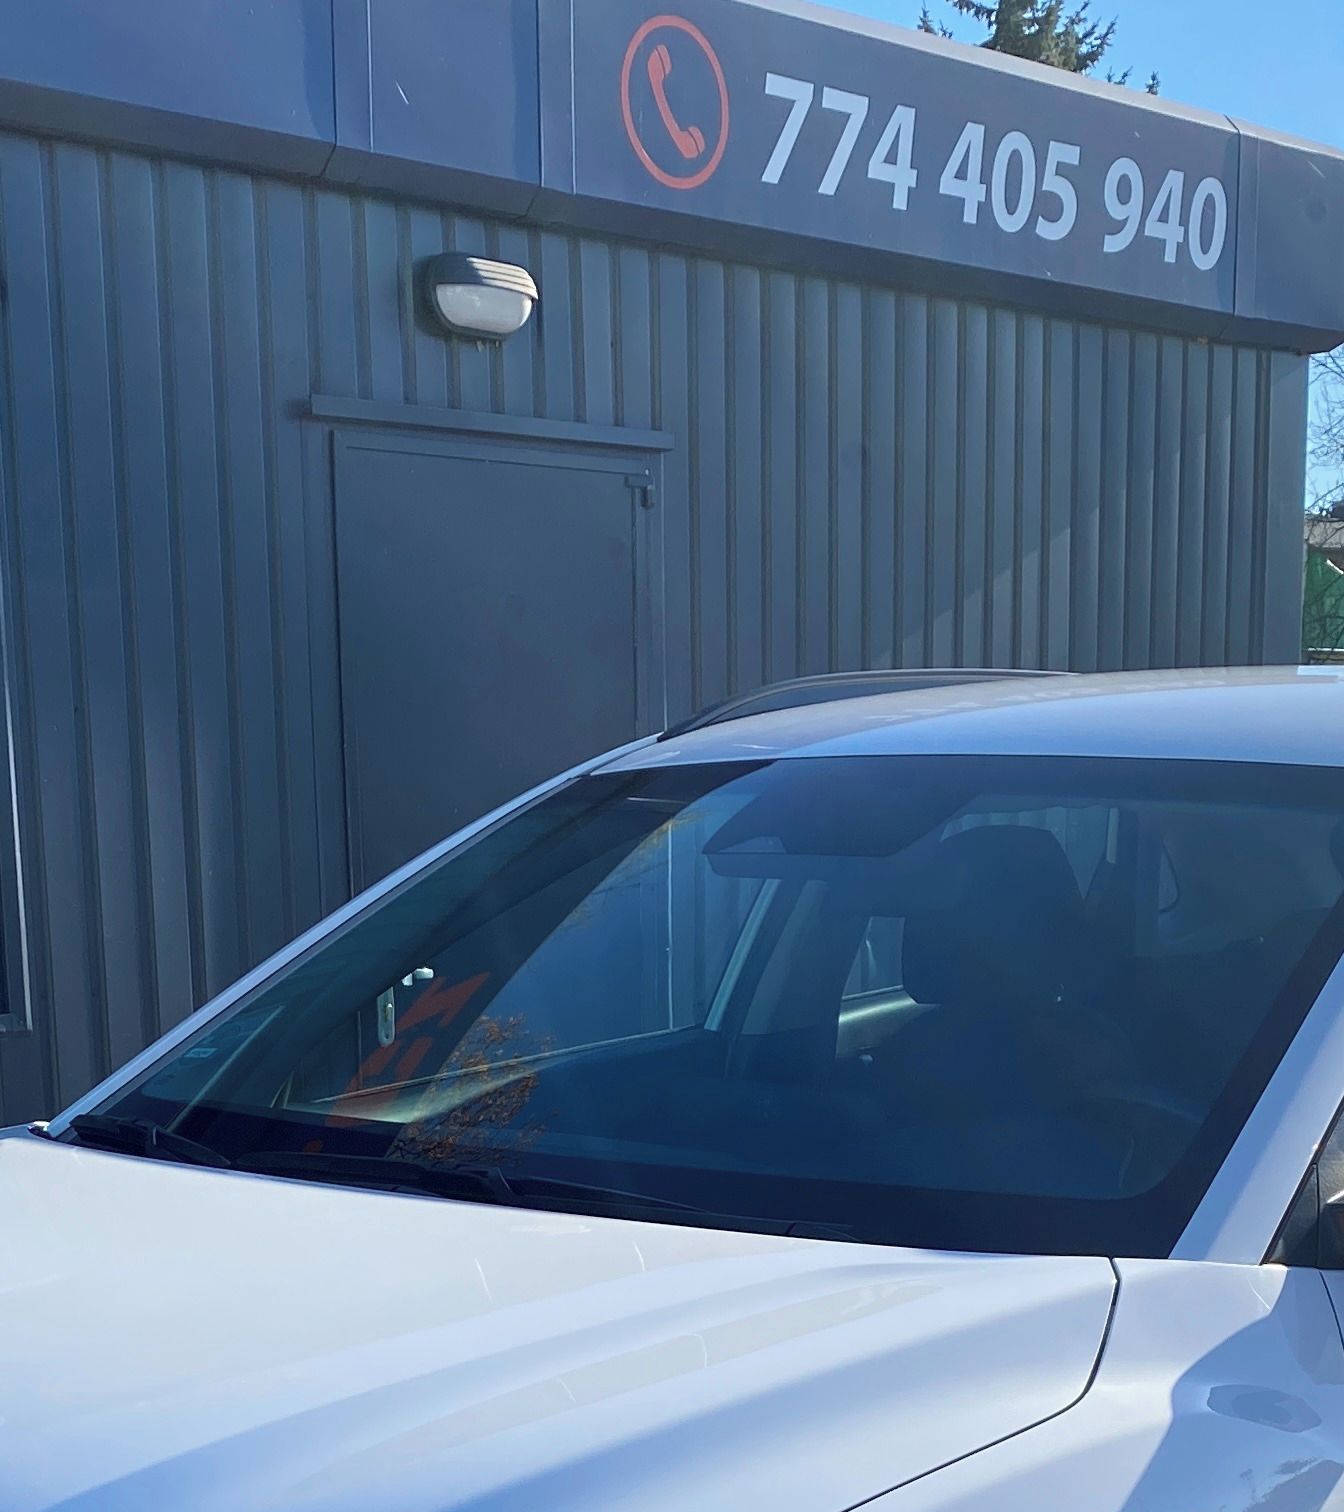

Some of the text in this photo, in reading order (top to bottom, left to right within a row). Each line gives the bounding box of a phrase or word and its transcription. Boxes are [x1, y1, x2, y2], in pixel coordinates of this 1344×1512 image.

[761, 72, 1228, 270] 774 405 940
